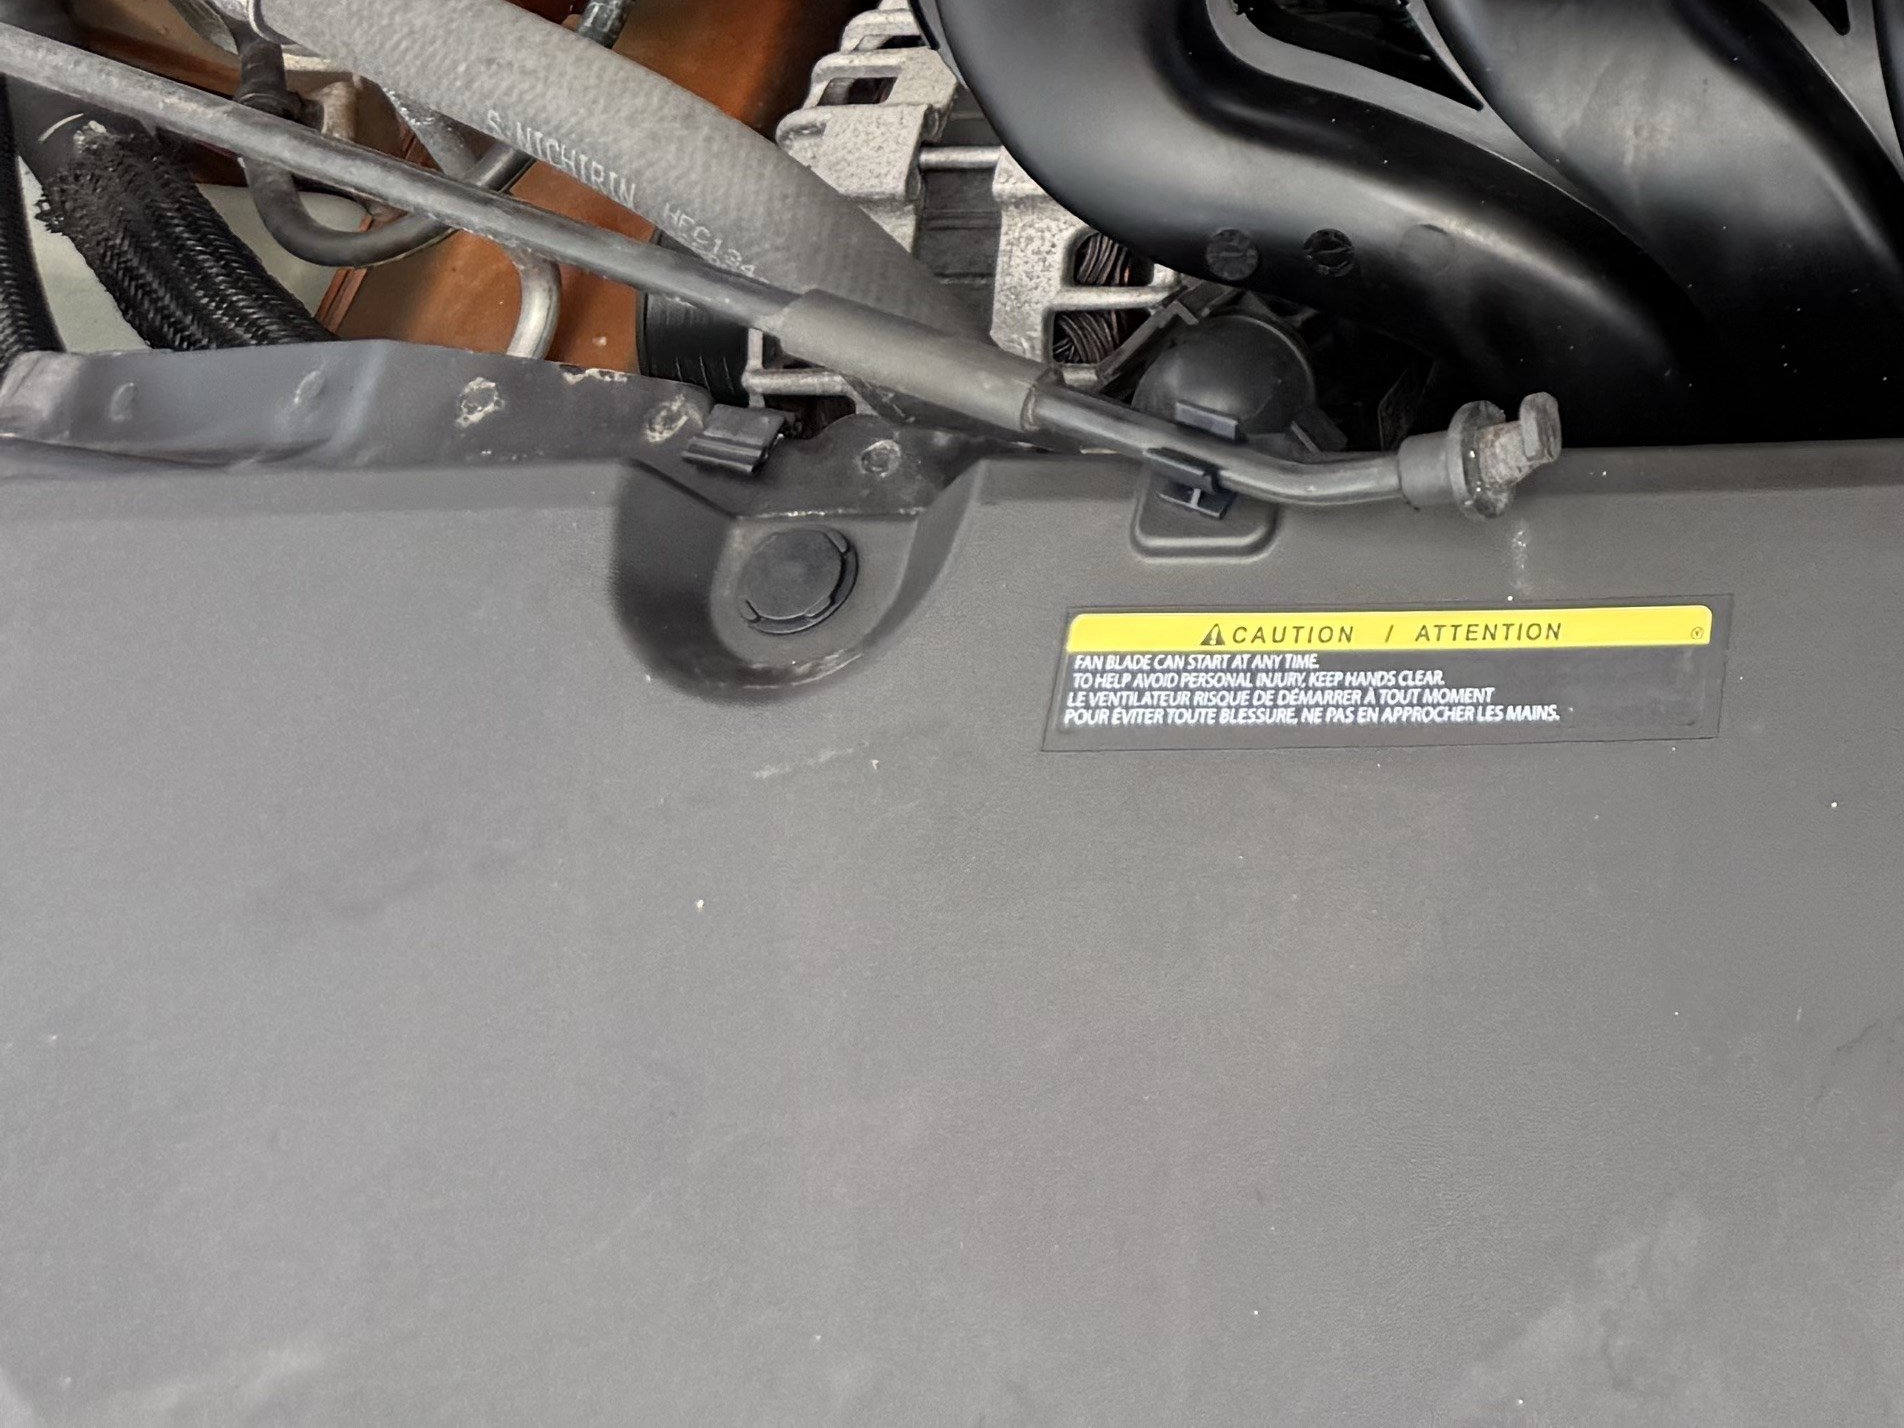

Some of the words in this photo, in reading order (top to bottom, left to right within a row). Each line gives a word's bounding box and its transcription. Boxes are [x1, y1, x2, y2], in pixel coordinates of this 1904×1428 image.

[1232, 625, 1354, 644] CAUTION
[1413, 622, 1562, 641] ATTENTION
[1074, 654, 1101, 669] FAN
[1103, 653, 1151, 669] BLADE
[1153, 653, 1182, 669] CAN
[1184, 652, 1230, 668] START
[1230, 652, 1250, 668] AT
[1251, 652, 1283, 668] ANY
[1284, 652, 1319, 667] TIME.
[1074, 672, 1094, 688] TO
[1095, 672, 1131, 687] HELP
[1132, 672, 1177, 687] AVOID
[1179, 671, 1252, 687] PERSONAL
[1309, 671, 1343, 686] KEEP
[1344, 670, 1397, 686] HANDS
[1399, 670, 1445, 685] CLEAR.
[1068, 689, 1084, 706] LE
[1084, 689, 1190, 706] VENTILATEUR
[1195, 688, 1250, 705] RISQUE
[1253, 688, 1275, 705] DE
[1278, 688, 1362, 704] DÉMARRER
[1364, 687, 1377, 704] À
[1378, 687, 1420, 704] TOUT
[1422, 687, 1494, 703] MOMENT
[1064, 707, 1109, 725] POUR
[1111, 707, 1164, 724] ÉVITER
[1166, 706, 1216, 724] TOUTE
[1301, 705, 1324, 723] NE
[1325, 705, 1354, 722] PAS
[1357, 705, 1378, 722] EN
[1381, 704, 1474, 722] APPROCHER
[1475, 704, 1504, 721] LES
[1506, 703, 1560, 721] MAINS.
